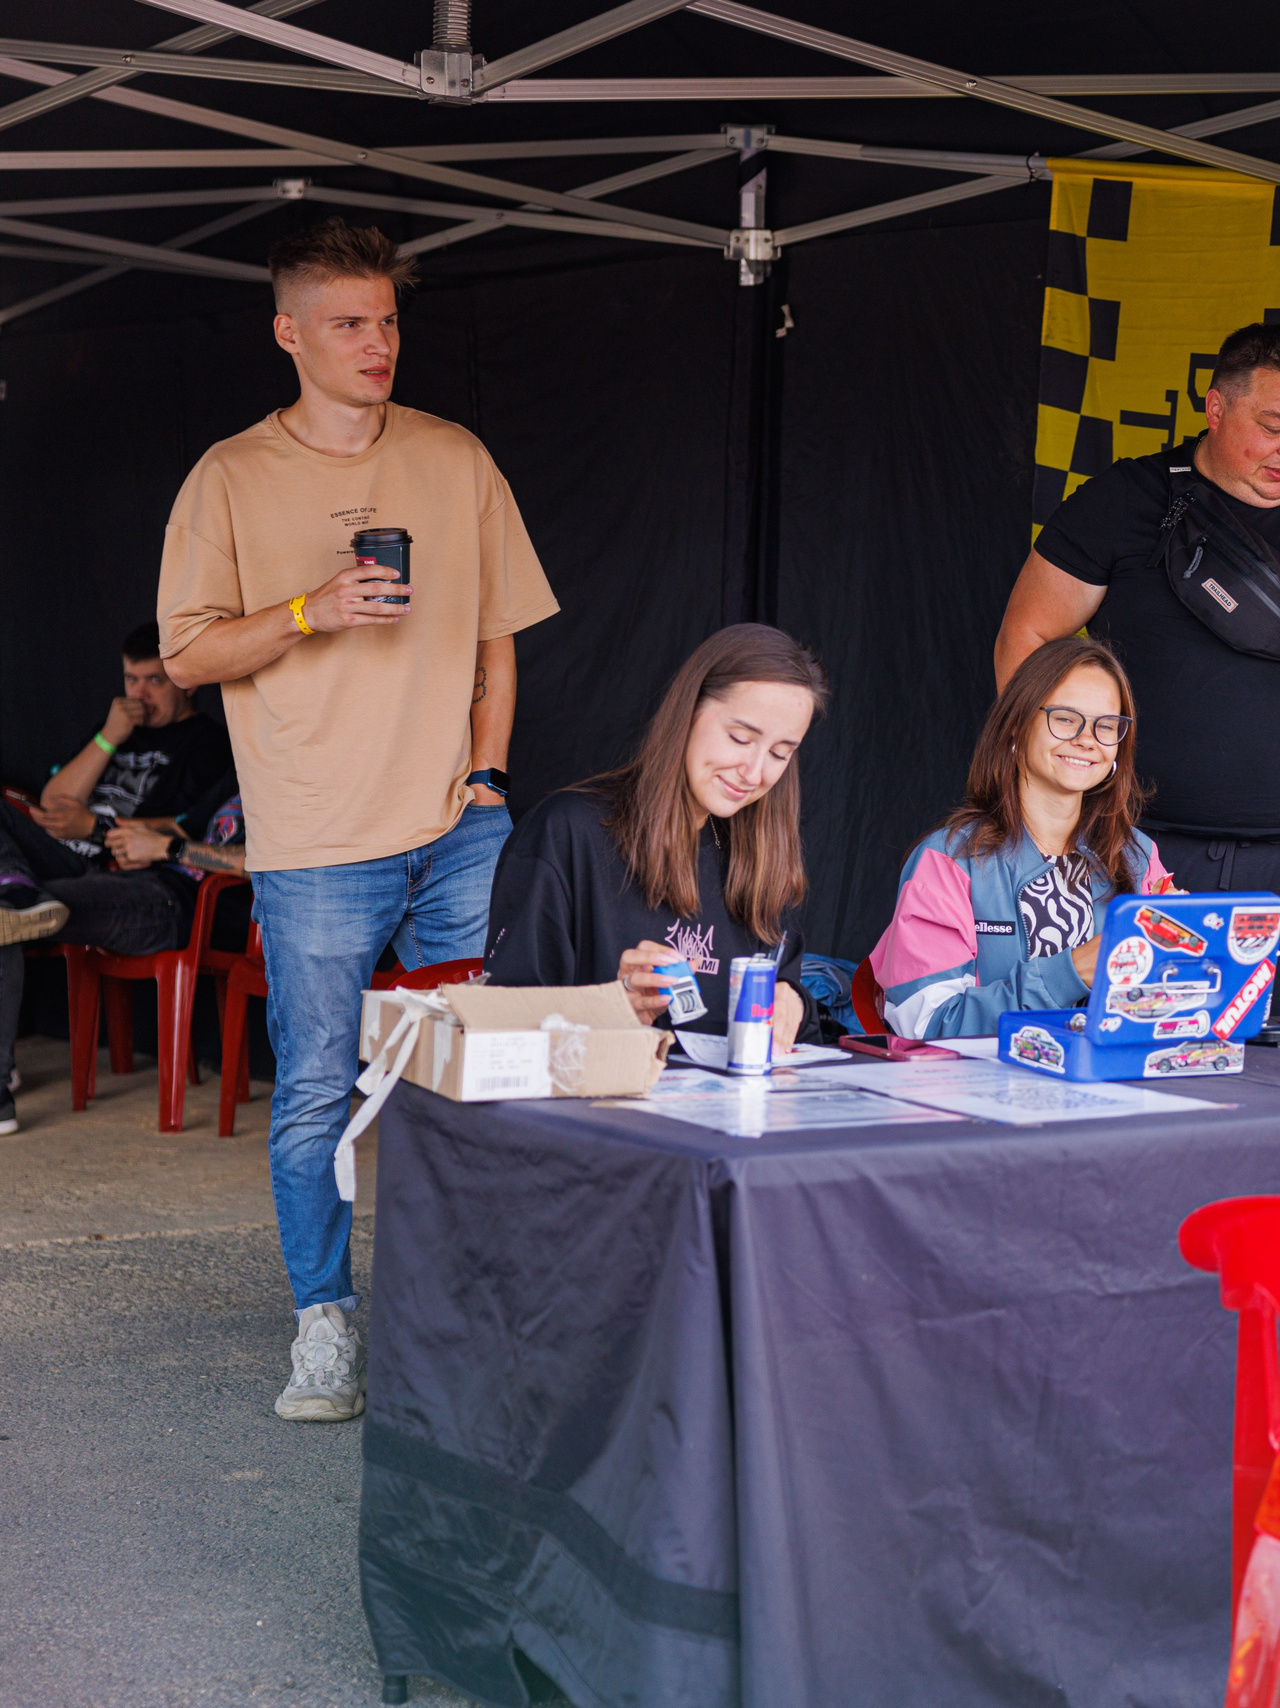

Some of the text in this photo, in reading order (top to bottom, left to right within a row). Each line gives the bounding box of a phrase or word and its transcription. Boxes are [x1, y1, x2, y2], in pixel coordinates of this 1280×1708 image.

[330, 508, 358, 518] ESSENCE
[1209, 583, 1232, 607] TRAILHEAD
[974, 921, 1013, 933] ellesse
[1215, 961, 1273, 1036] MOTUL
